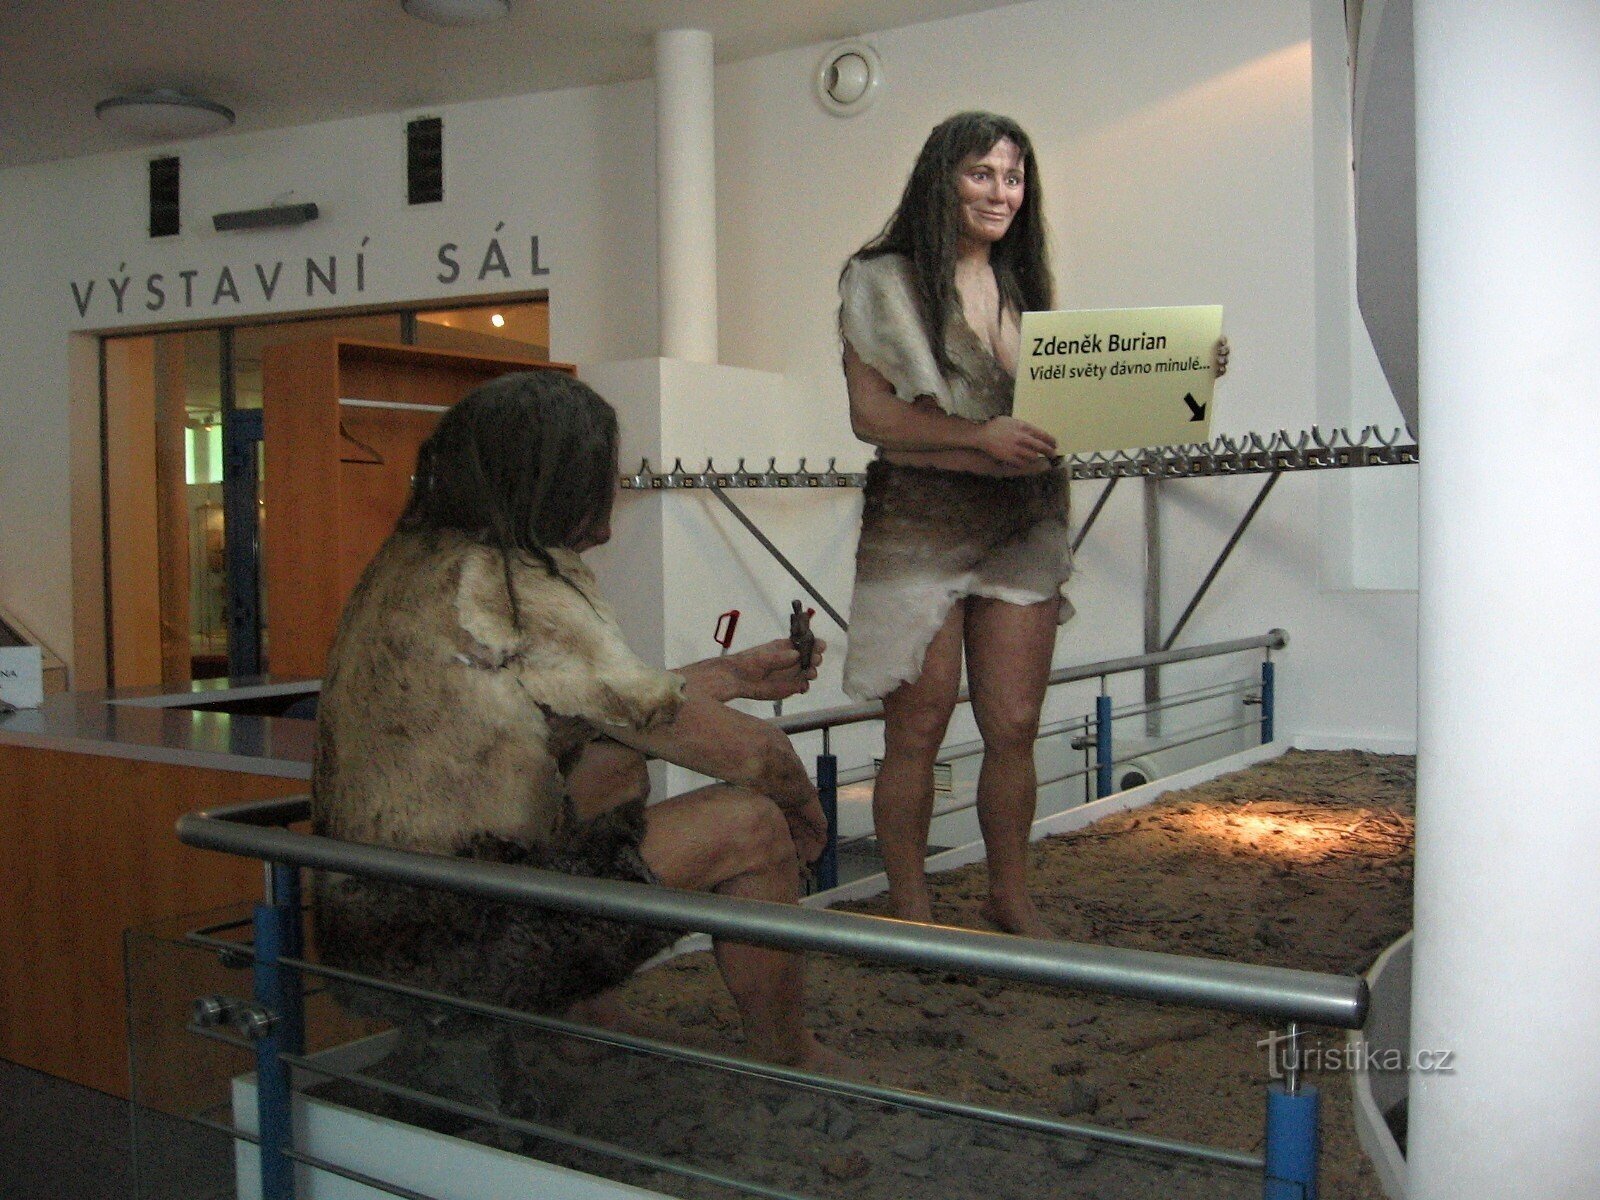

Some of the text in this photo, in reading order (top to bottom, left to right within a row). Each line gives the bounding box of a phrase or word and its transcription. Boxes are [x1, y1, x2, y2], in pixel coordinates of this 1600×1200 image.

[71, 222, 551, 317] VÝSTAVNÍ SÁL
[1032, 332, 1166, 356] Zdeněk Burian
[1030, 365, 1065, 380] Viděl
[1069, 364, 1106, 380] světy
[1110, 361, 1151, 376] dávno
